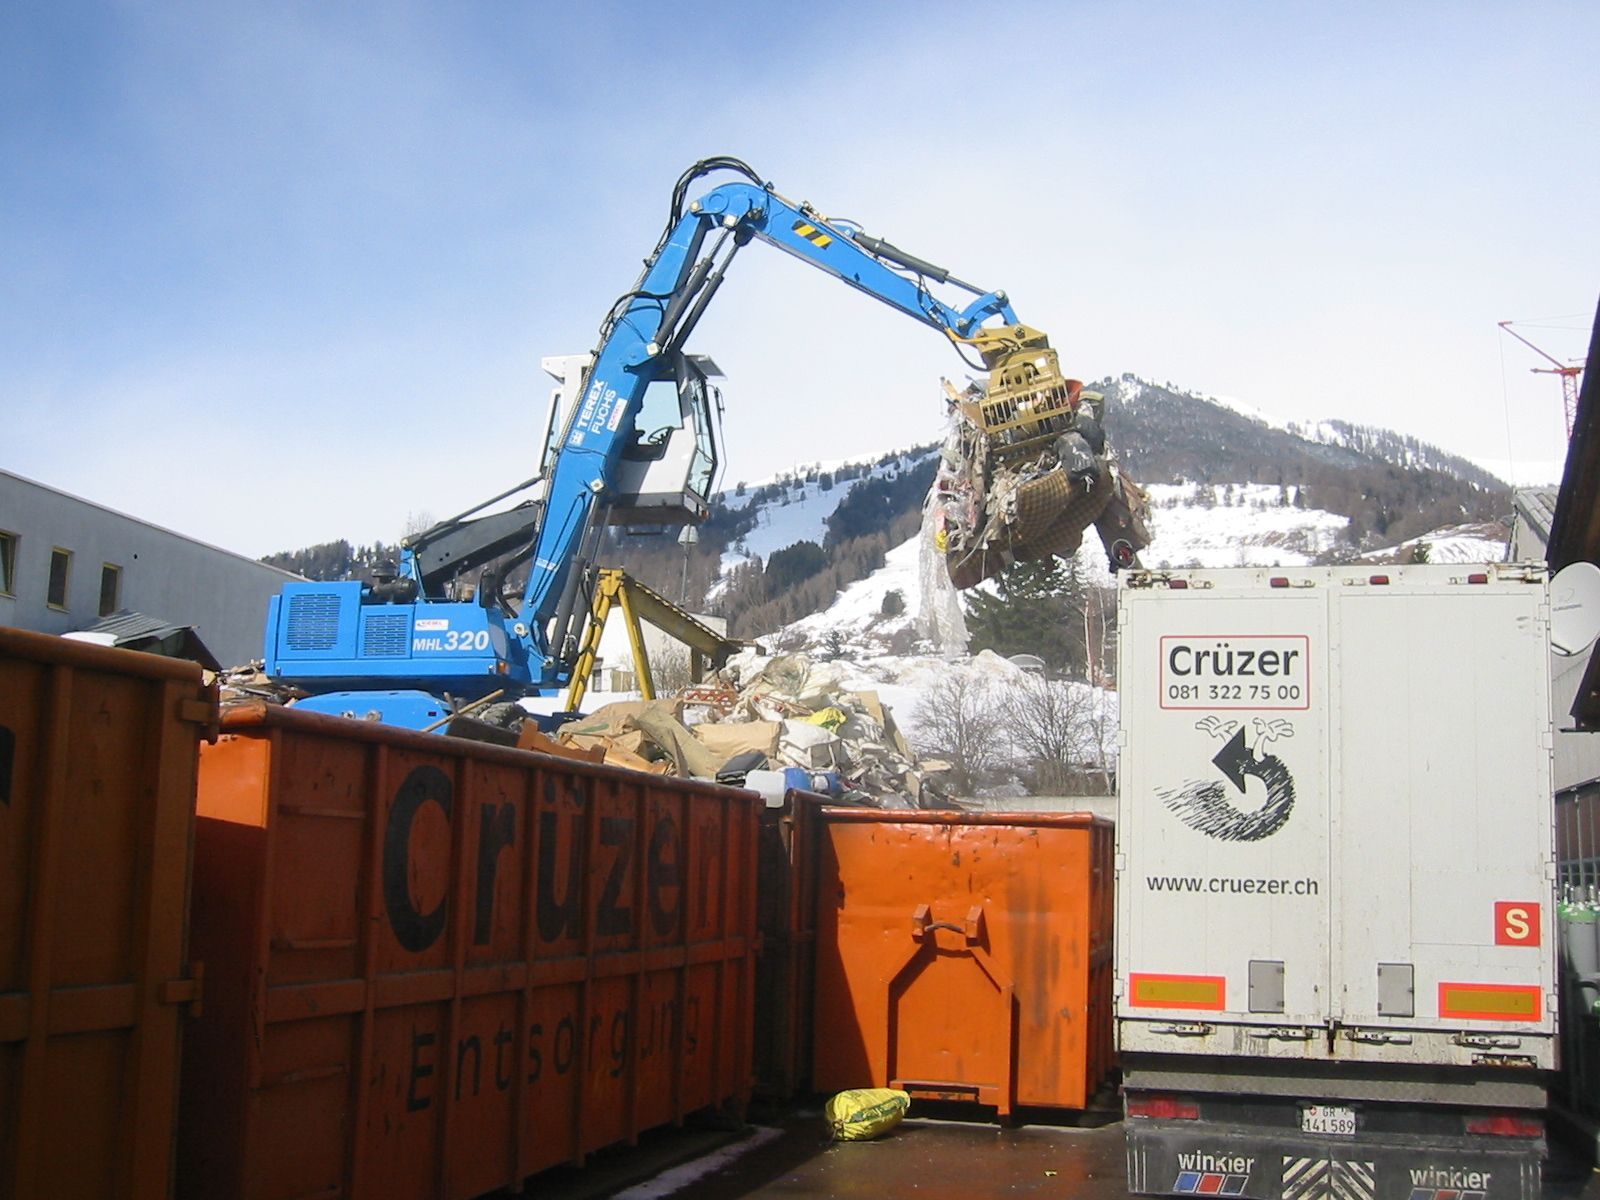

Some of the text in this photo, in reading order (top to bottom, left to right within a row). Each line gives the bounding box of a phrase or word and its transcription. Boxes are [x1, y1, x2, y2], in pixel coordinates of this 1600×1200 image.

[577, 379, 605, 428] TEREX
[591, 389, 617, 435] FUCHS
[413, 630, 490, 651] MHL 320
[1169, 642, 1299, 676] Crüzer
[1168, 684, 1300, 700] 081 322 75 00
[1146, 876, 1319, 895] www.cruezer.ch
[1505, 908, 1530, 940] S
